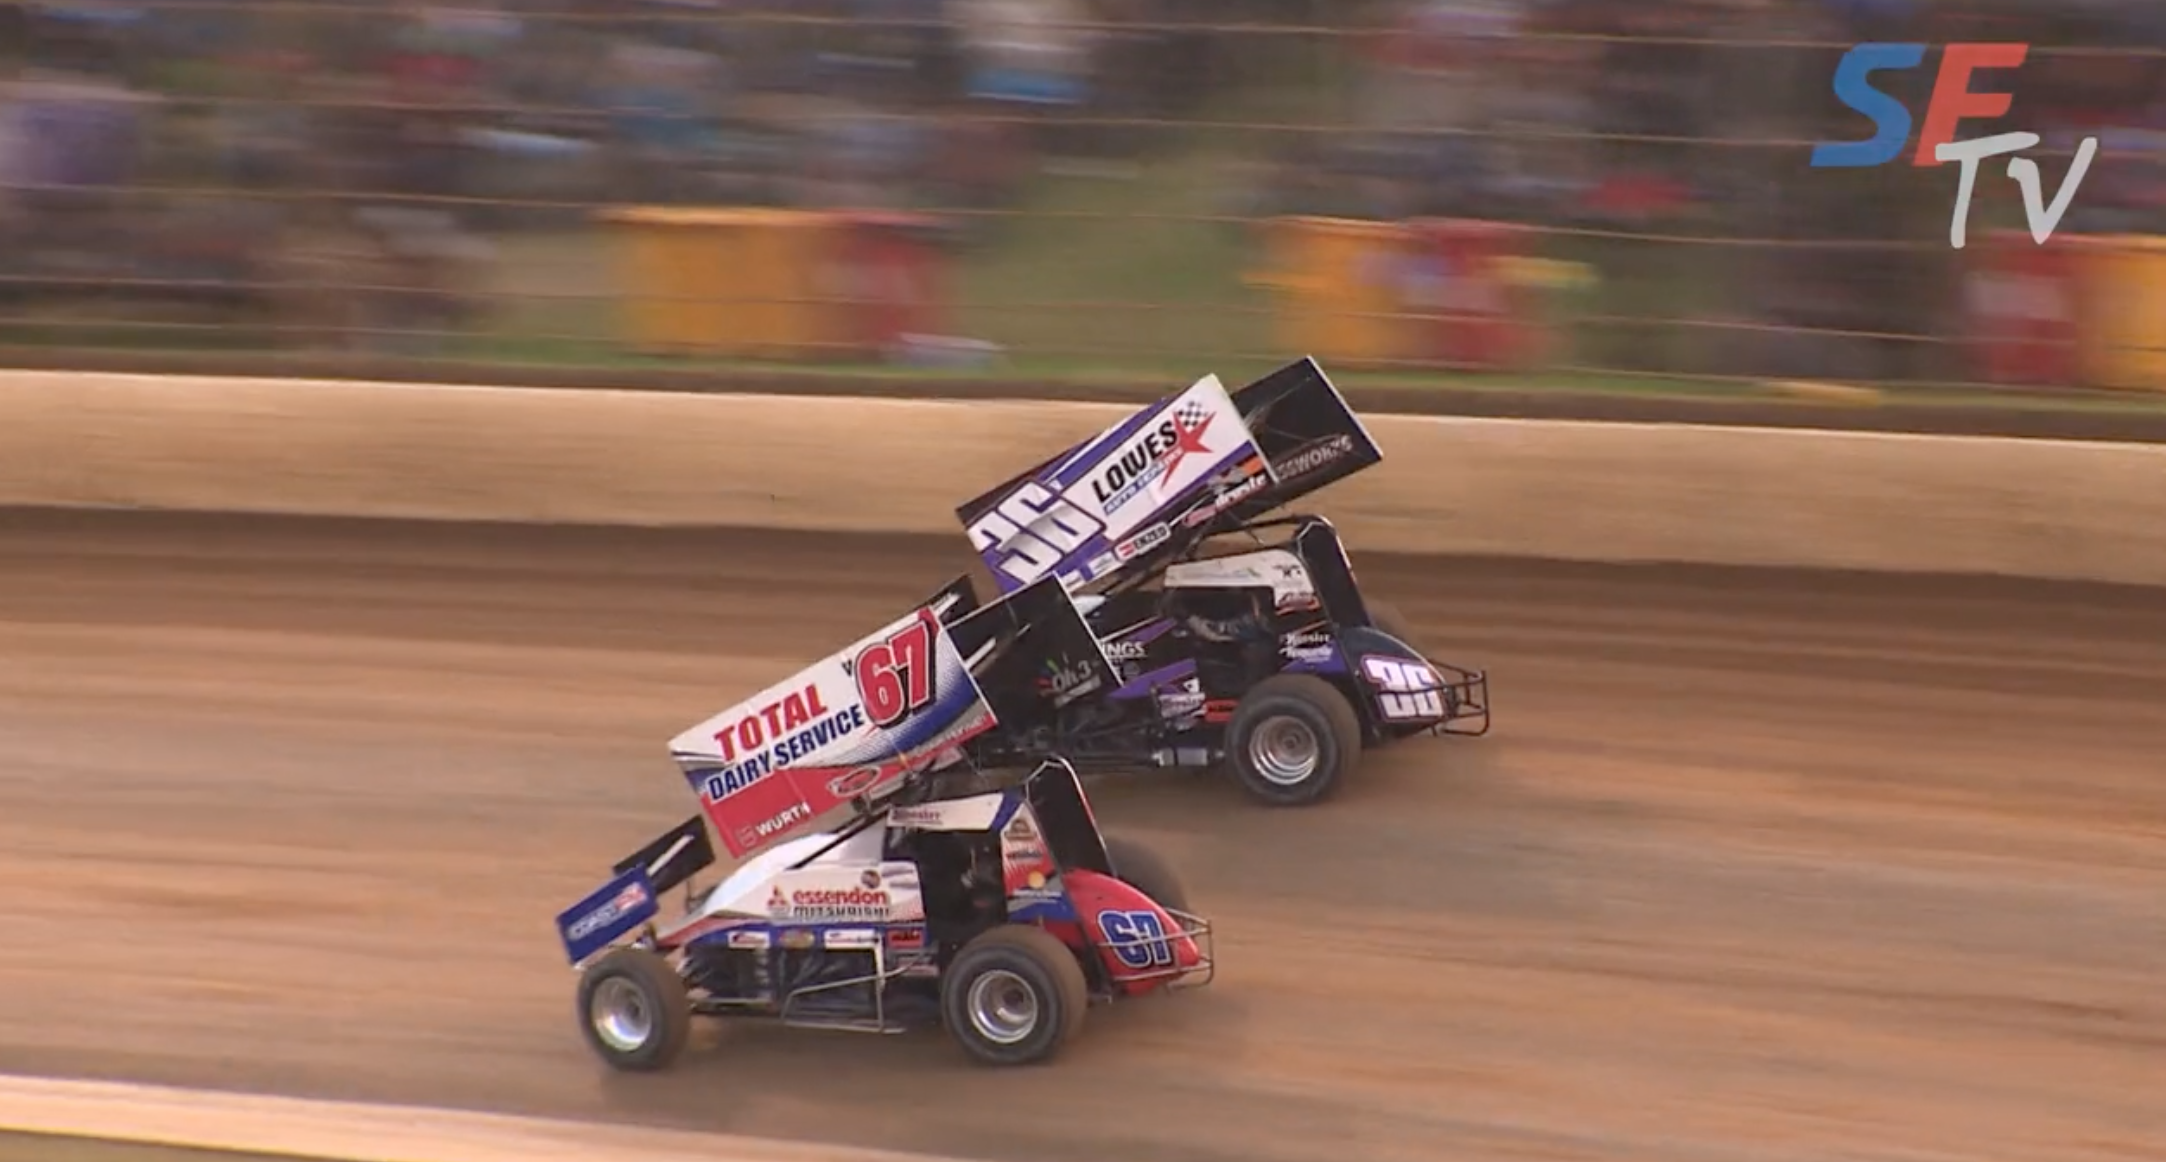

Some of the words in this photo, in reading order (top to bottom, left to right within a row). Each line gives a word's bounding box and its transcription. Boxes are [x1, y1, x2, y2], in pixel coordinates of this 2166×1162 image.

[1092, 420, 1177, 503] LOWES
[966, 480, 1104, 586] 36
[855, 619, 938, 730] 67
[1362, 656, 1445, 721] 36
[707, 749, 771, 801] DAIRY
[774, 703, 865, 767] SERVICE
[714, 683, 828, 763] TOTAL
[792, 886, 888, 905] essendon
[1098, 909, 1172, 968] 67
